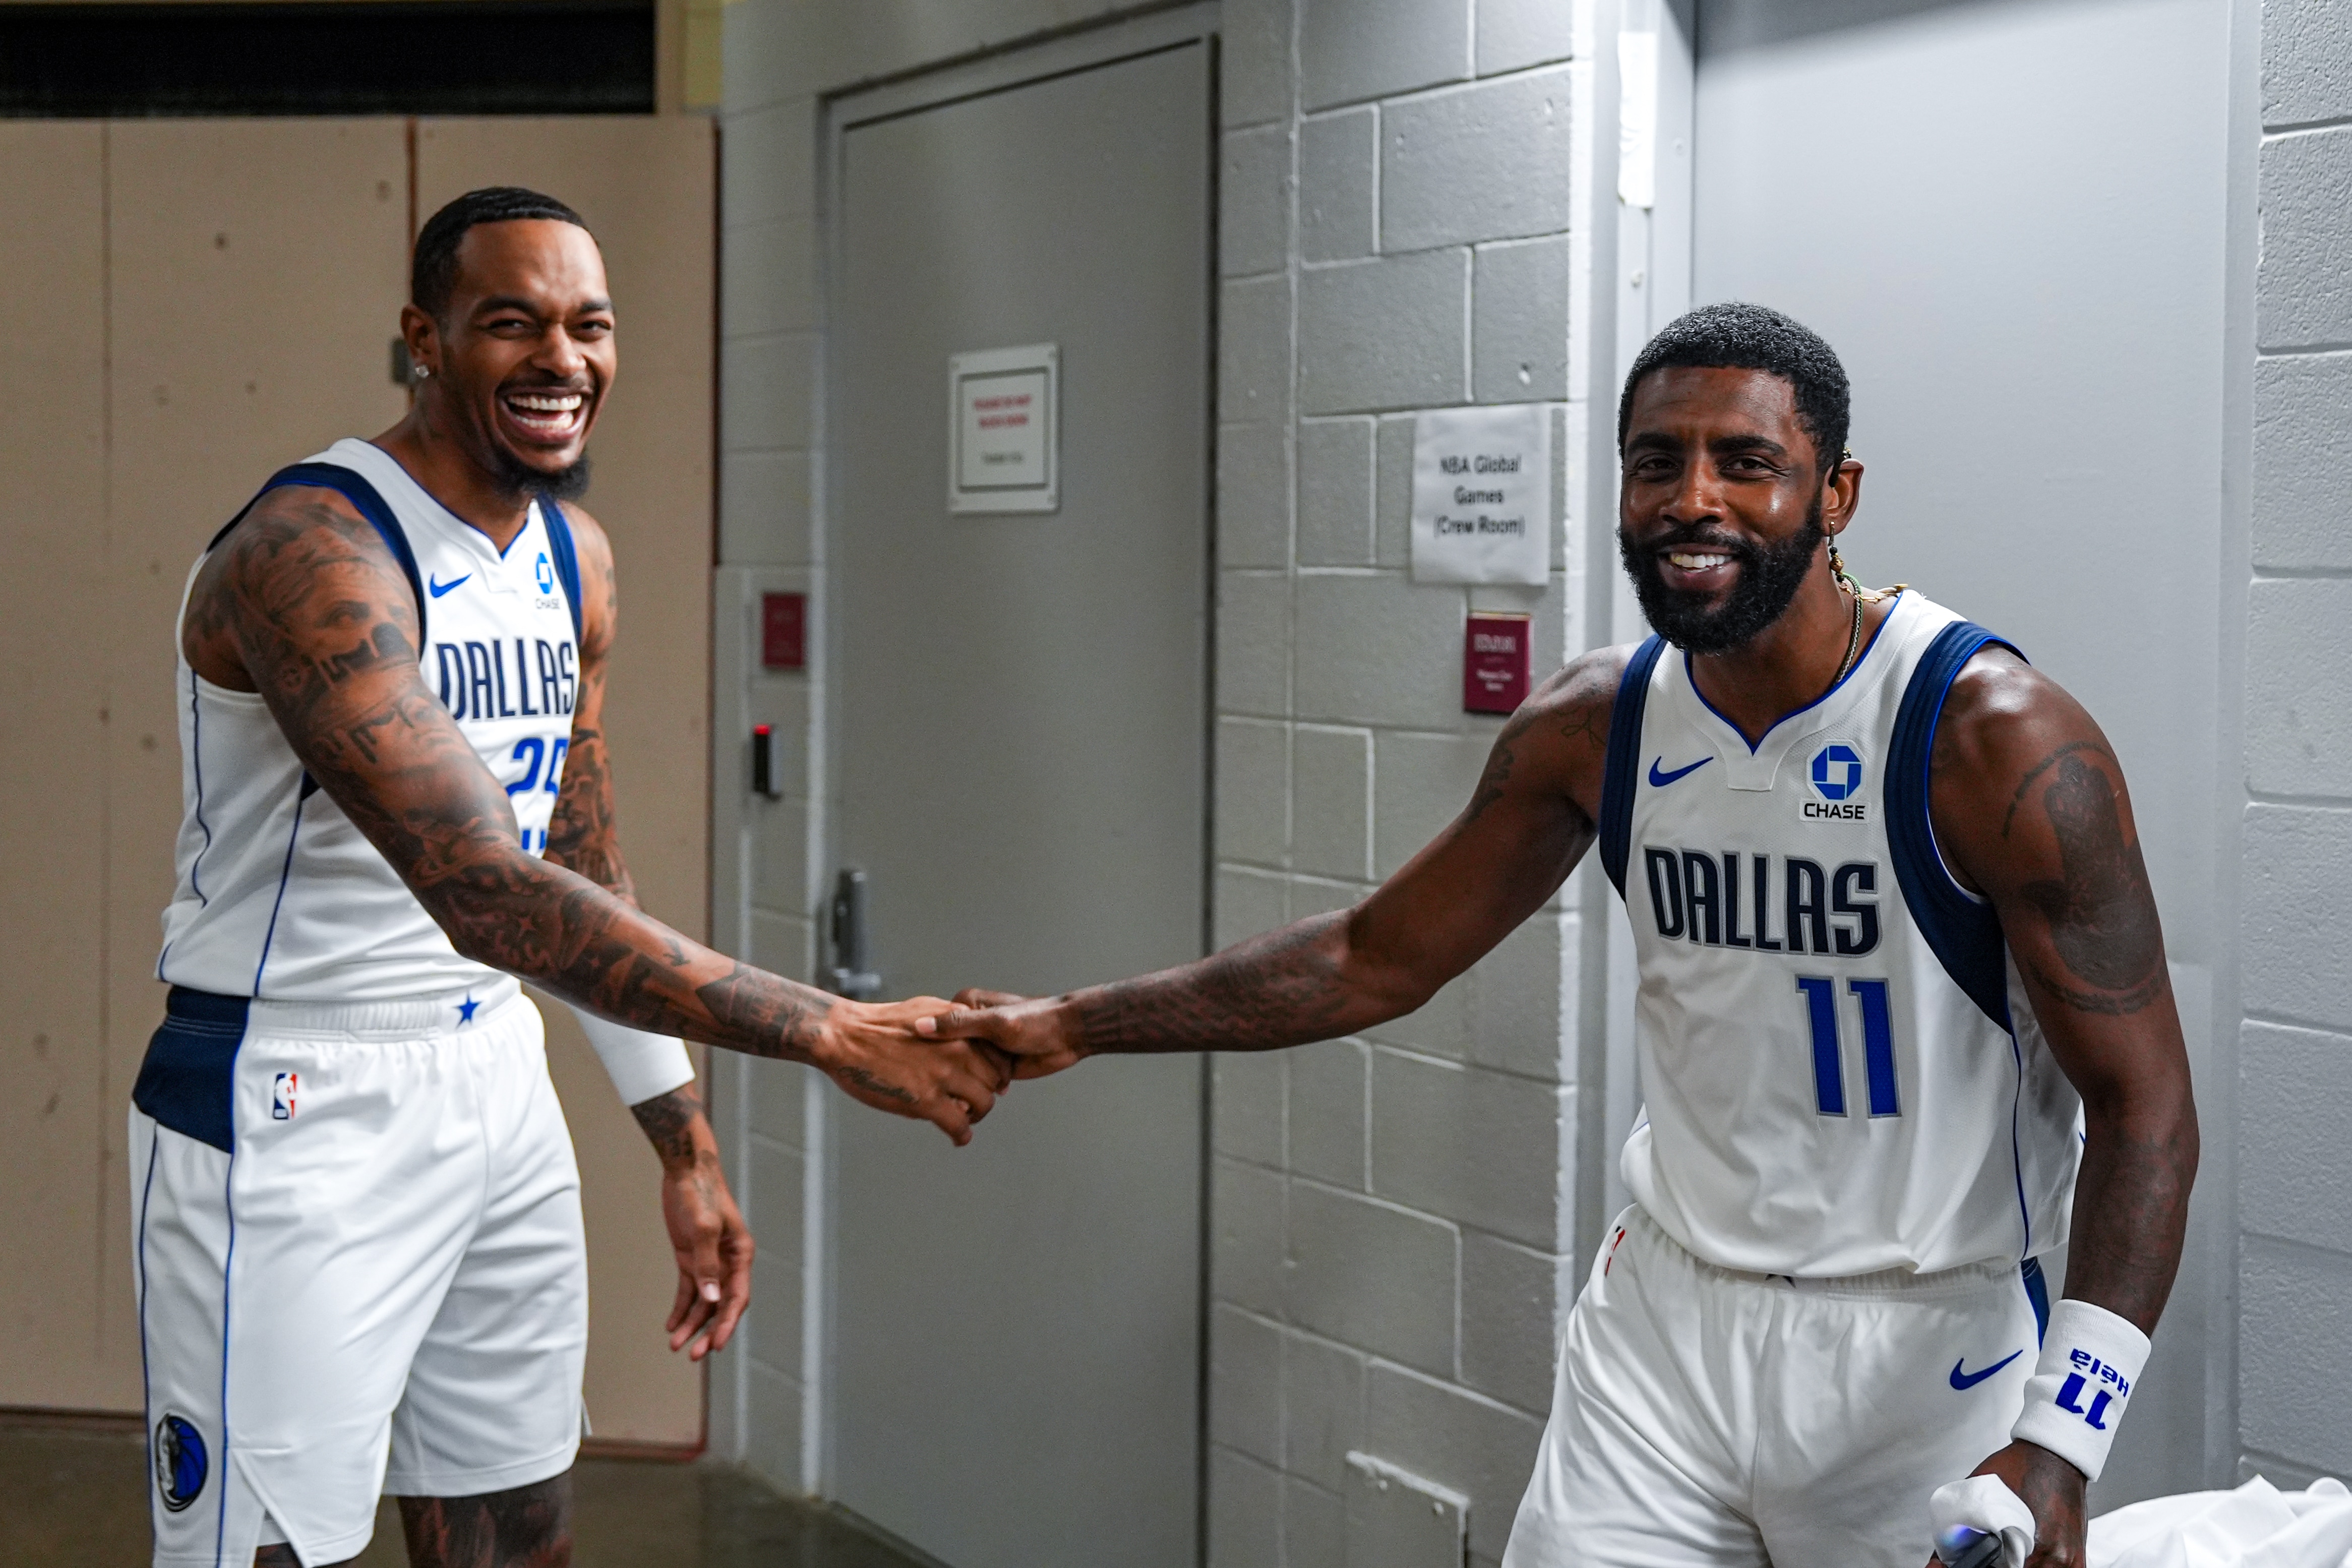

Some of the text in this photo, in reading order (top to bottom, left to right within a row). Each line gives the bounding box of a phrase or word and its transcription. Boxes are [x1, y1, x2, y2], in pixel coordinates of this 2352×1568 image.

[1439, 454, 1522, 473] NBA Global
[1454, 485, 1504, 505] Games
[1433, 515, 1525, 537] (Crew Room)
[536, 598, 560, 609] CHASE
[435, 637, 574, 720] DALLAS
[1804, 803, 1865, 819] CHASE
[1644, 845, 1883, 958] DALLAS
[1795, 974, 1902, 1118] 11
[2055, 1372, 2113, 1430] 11
